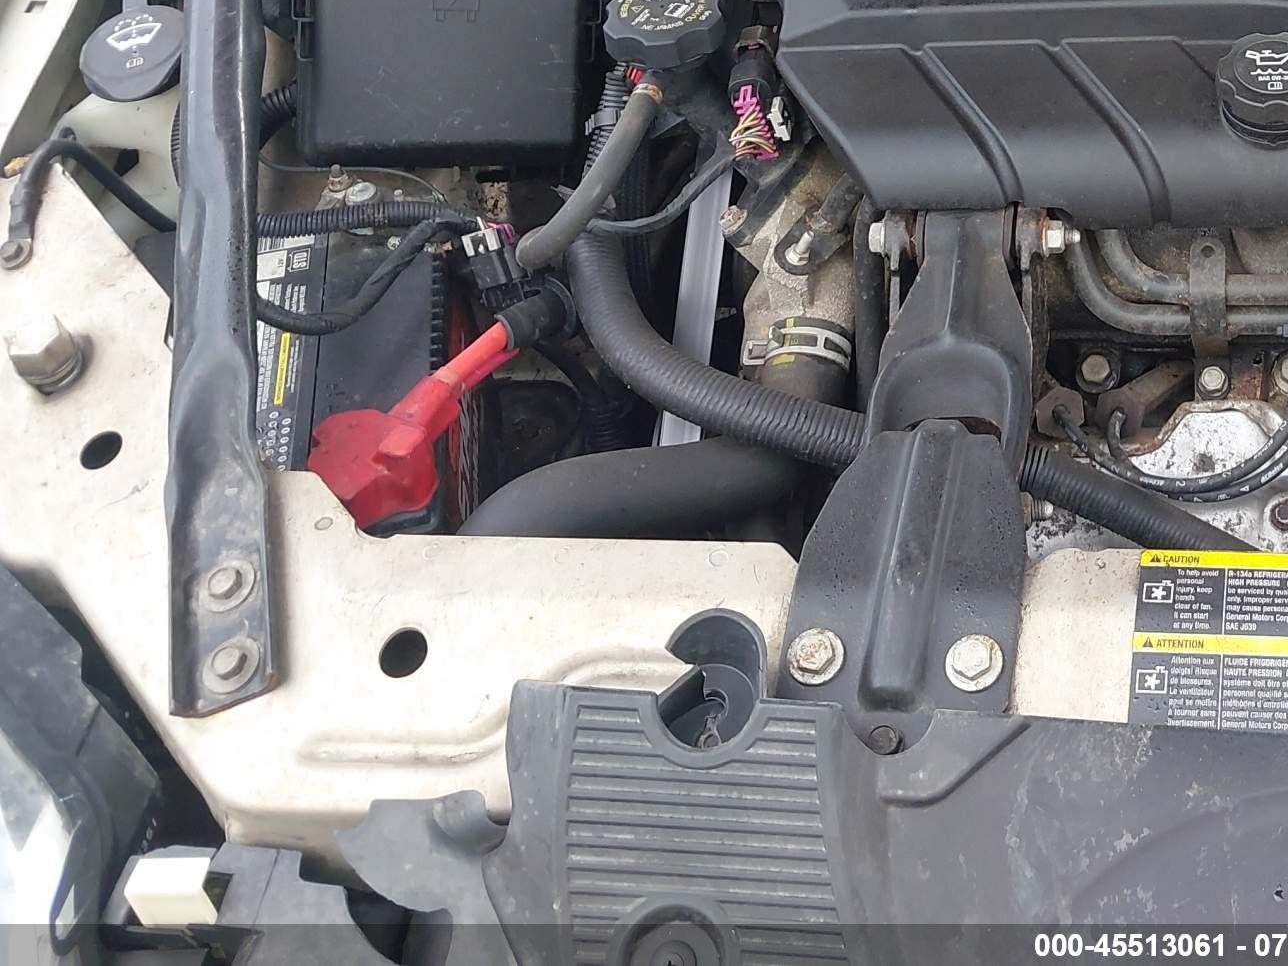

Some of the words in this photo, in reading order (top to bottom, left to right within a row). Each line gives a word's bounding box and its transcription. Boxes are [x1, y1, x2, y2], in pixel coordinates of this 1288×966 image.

[293, 251, 308, 269] STD
[1186, 569, 1200, 577] help
[1246, 579, 1280, 587] PRESSURE
[1196, 586, 1212, 594] keep
[1266, 588, 1273, 596] by
[1243, 596, 1272, 604] Improper
[1252, 613, 1274, 621] Motors
[1181, 622, 1193, 630] any
[1226, 623, 1239, 631] SAE
[1156, 639, 1204, 648] ATTENTION
[1171, 656, 1201, 664] Attention
[1224, 657, 1248, 667] FLUIDE
[1224, 667, 1247, 677] HAUTE
[1248, 668, 1282, 678] PRESSION
[1180, 678, 1214, 686] blessures.
[1223, 678, 1251, 688] système
[1253, 679, 1266, 688] doit
[1267, 680, 1280, 688] être
[1223, 689, 1256, 699] personnel
[1194, 699, 1217, 707] mettre
[1222, 710, 1249, 719] peuvent
[1250, 711, 1273, 719] causer
[1275, 711, 1287, 719] des
[1221, 720, 1247, 728] General
[1248, 720, 1272, 729] Motors
